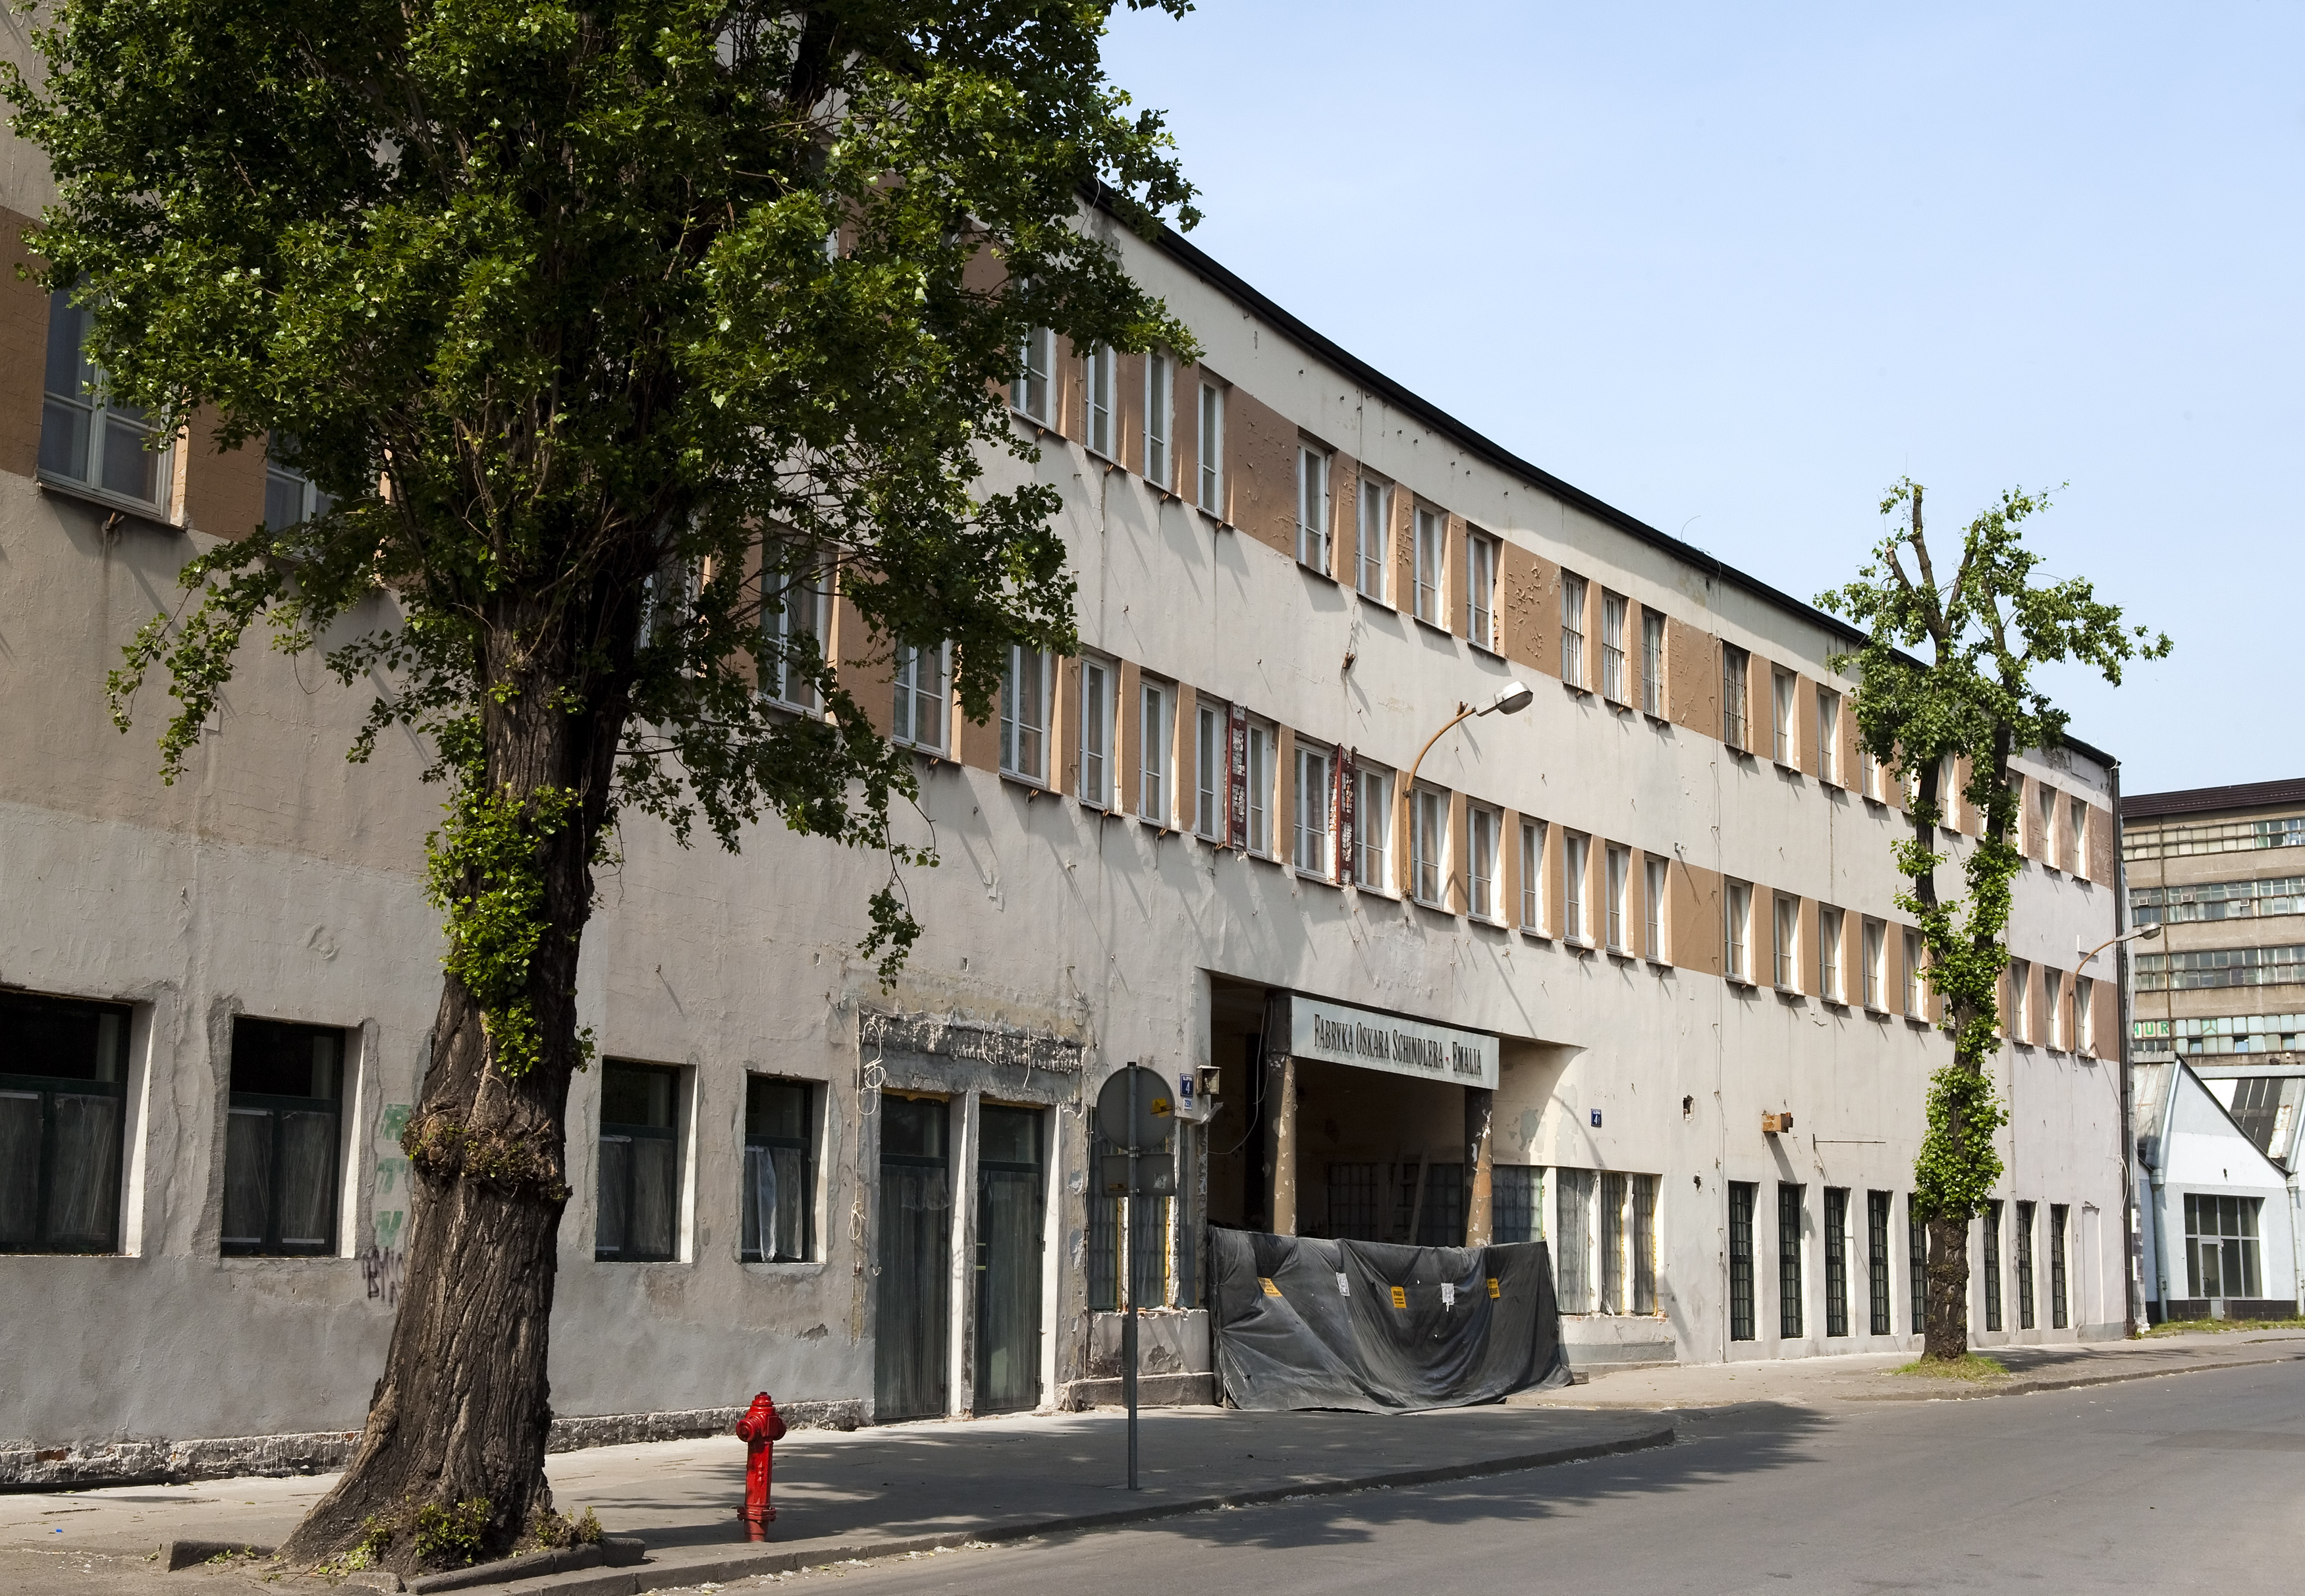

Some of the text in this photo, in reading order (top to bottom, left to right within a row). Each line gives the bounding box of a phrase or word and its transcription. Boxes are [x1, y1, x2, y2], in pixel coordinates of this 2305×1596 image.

[1315, 1014, 1353, 1053] FABRYKA
[1357, 1022, 1390, 1059] OSKARA
[1393, 1029, 1444, 1069] SCHINDLERA
[1452, 1042, 1482, 1075] EMALIA
[1185, 1081, 1190, 1094] 4
